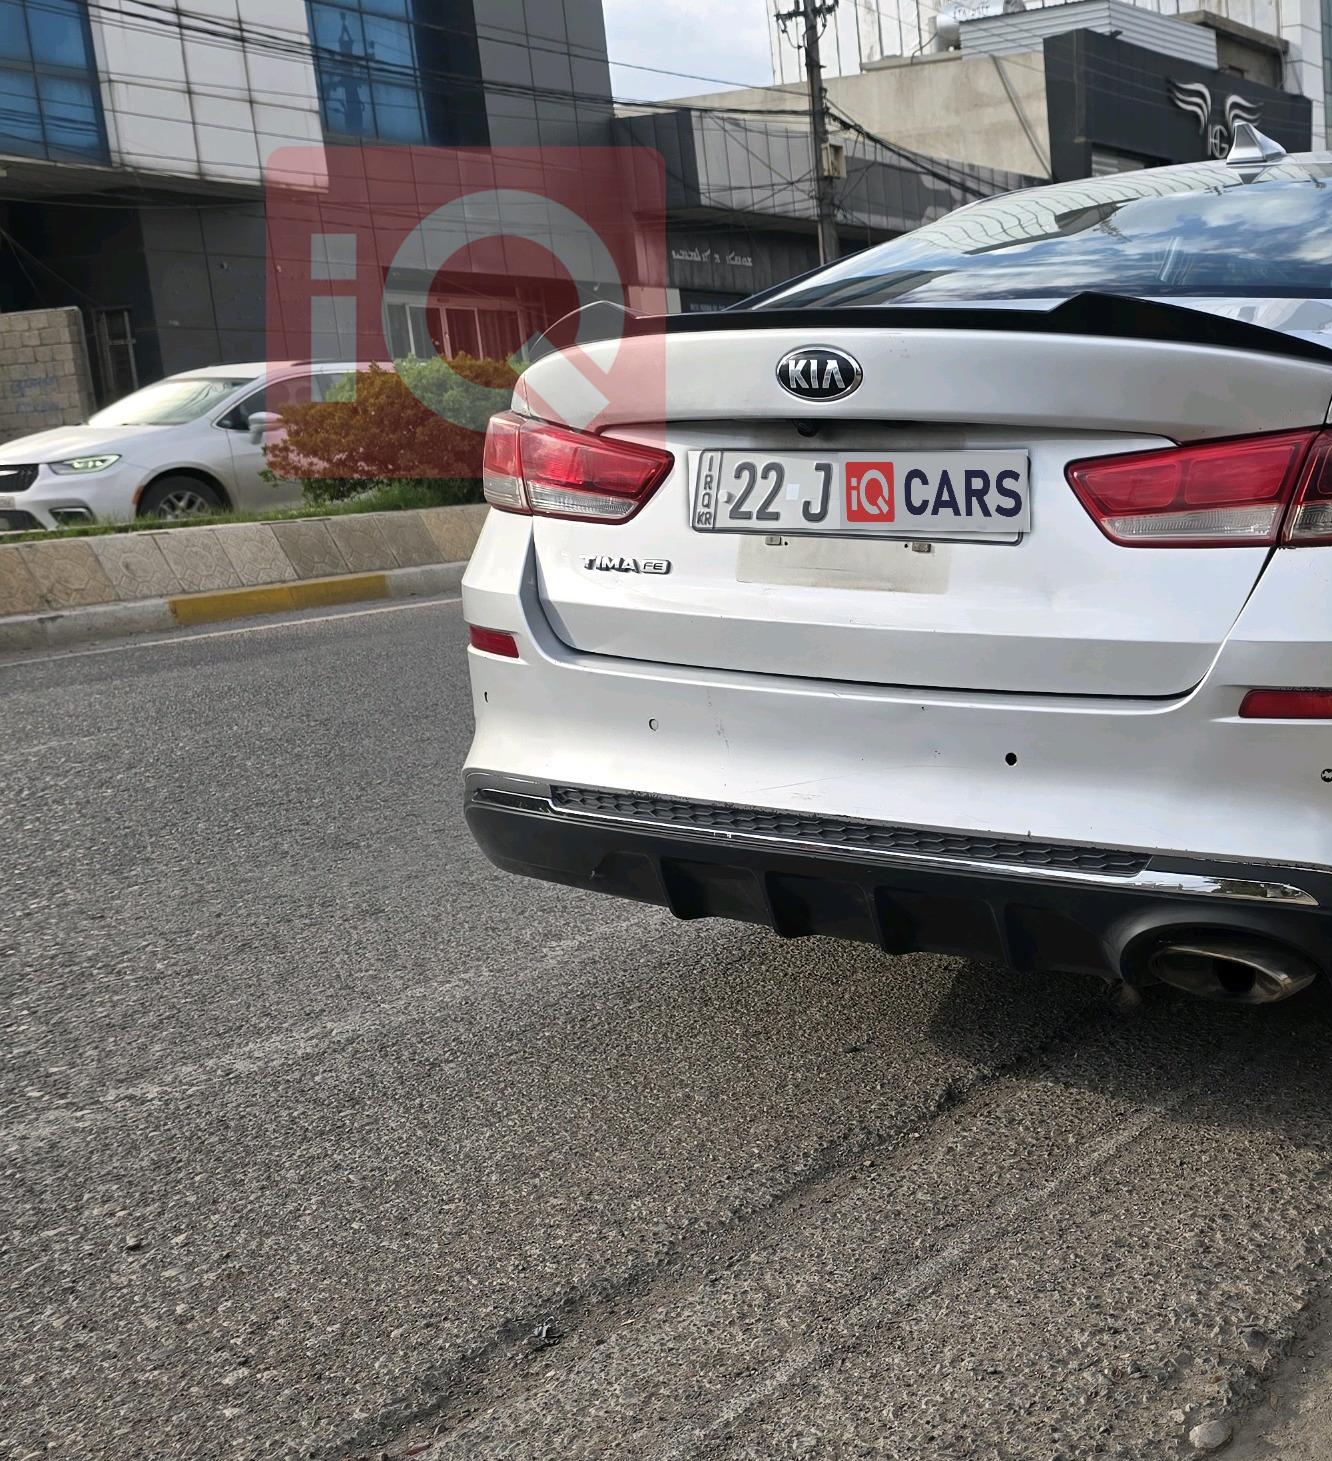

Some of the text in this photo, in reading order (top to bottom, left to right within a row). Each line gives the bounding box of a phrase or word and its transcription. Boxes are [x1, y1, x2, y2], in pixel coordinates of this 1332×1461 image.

[788, 359, 846, 389] KIA
[729, 461, 833, 522] 22 J
[697, 510, 712, 525] KR
[579, 555, 640, 573] TIMA
